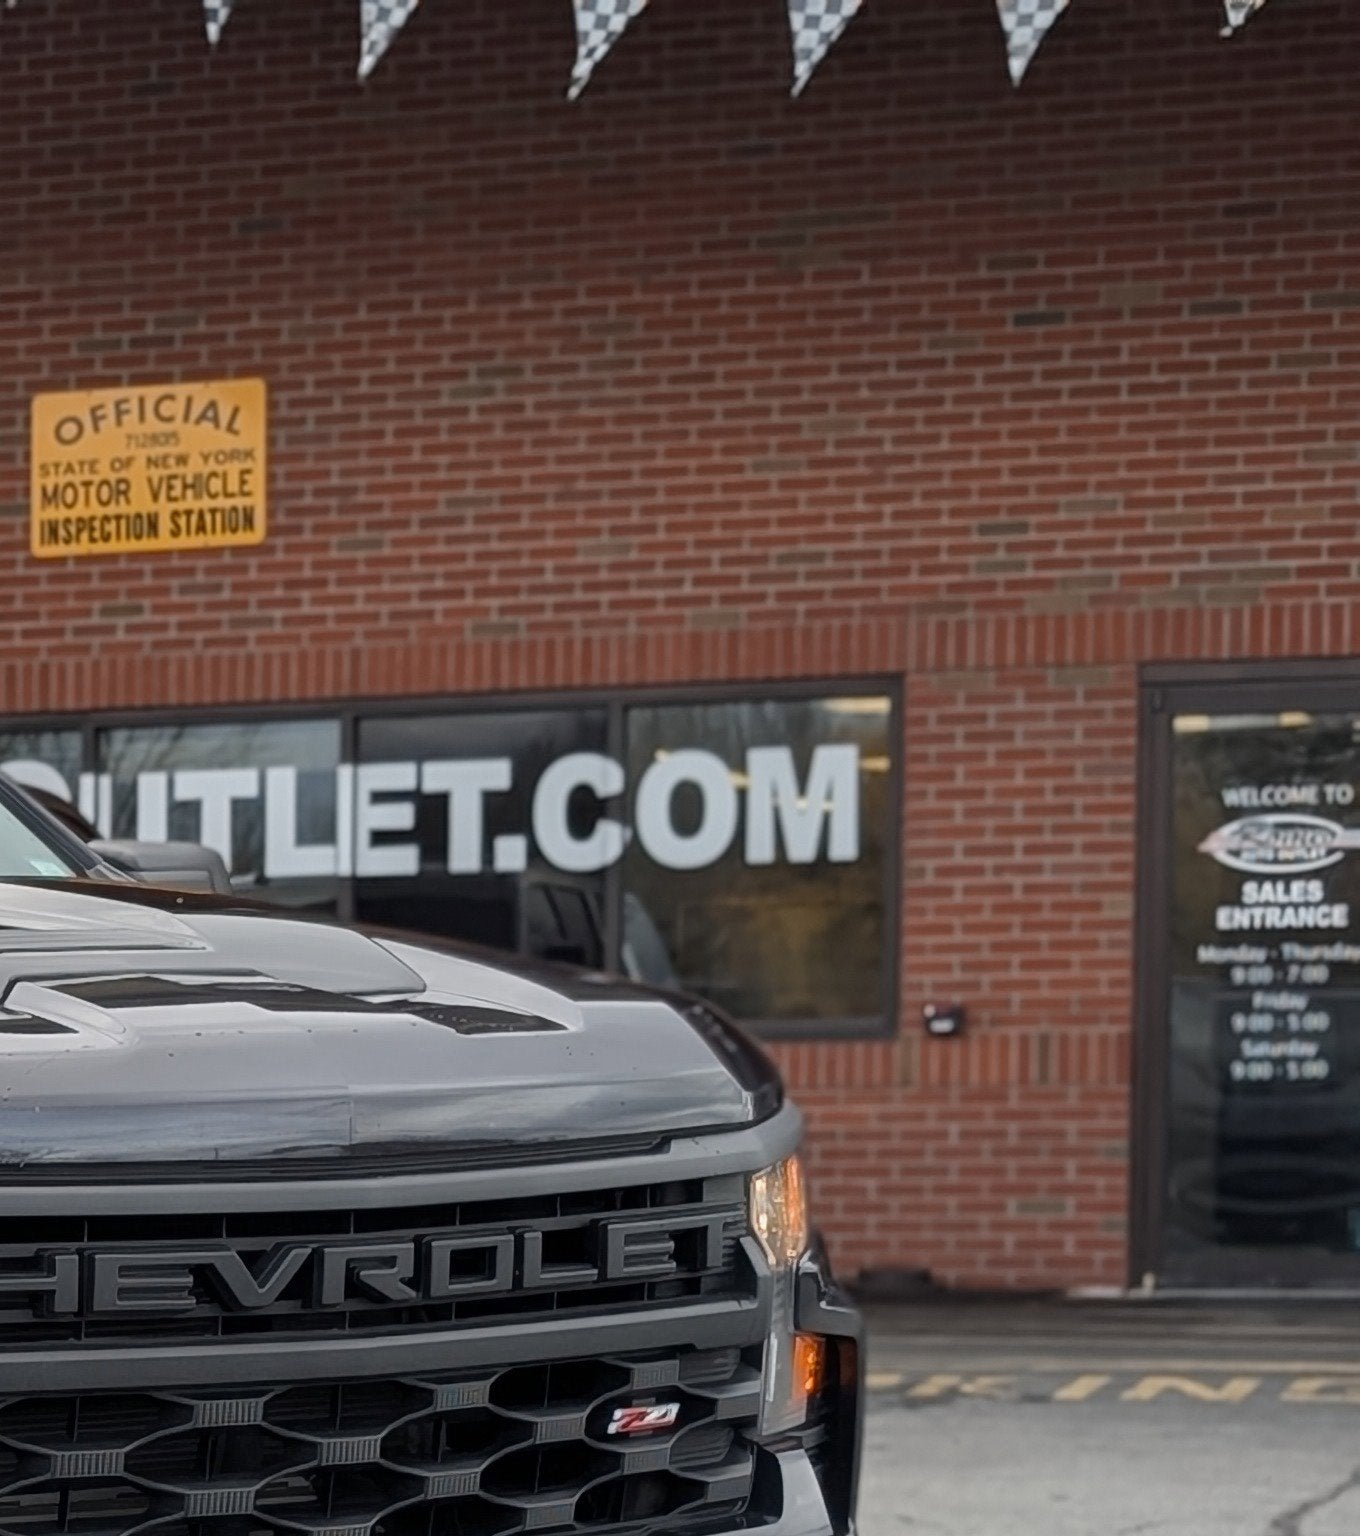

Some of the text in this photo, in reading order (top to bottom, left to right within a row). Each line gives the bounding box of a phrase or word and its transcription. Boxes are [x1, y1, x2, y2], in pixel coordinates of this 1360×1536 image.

[54, 394, 242, 446] OFFICIAL
[39, 448, 256, 478] STATE OF NEW YORK
[40, 469, 254, 511] MOTOR VEHICLE
[39, 505, 255, 547] INSPECTION STATION
[1221, 782, 1355, 807] WELCOME TO
[1241, 879, 1324, 905] SALES
[1216, 903, 1349, 931] ENTRANCE
[607, 1403, 680, 1434] Z71
